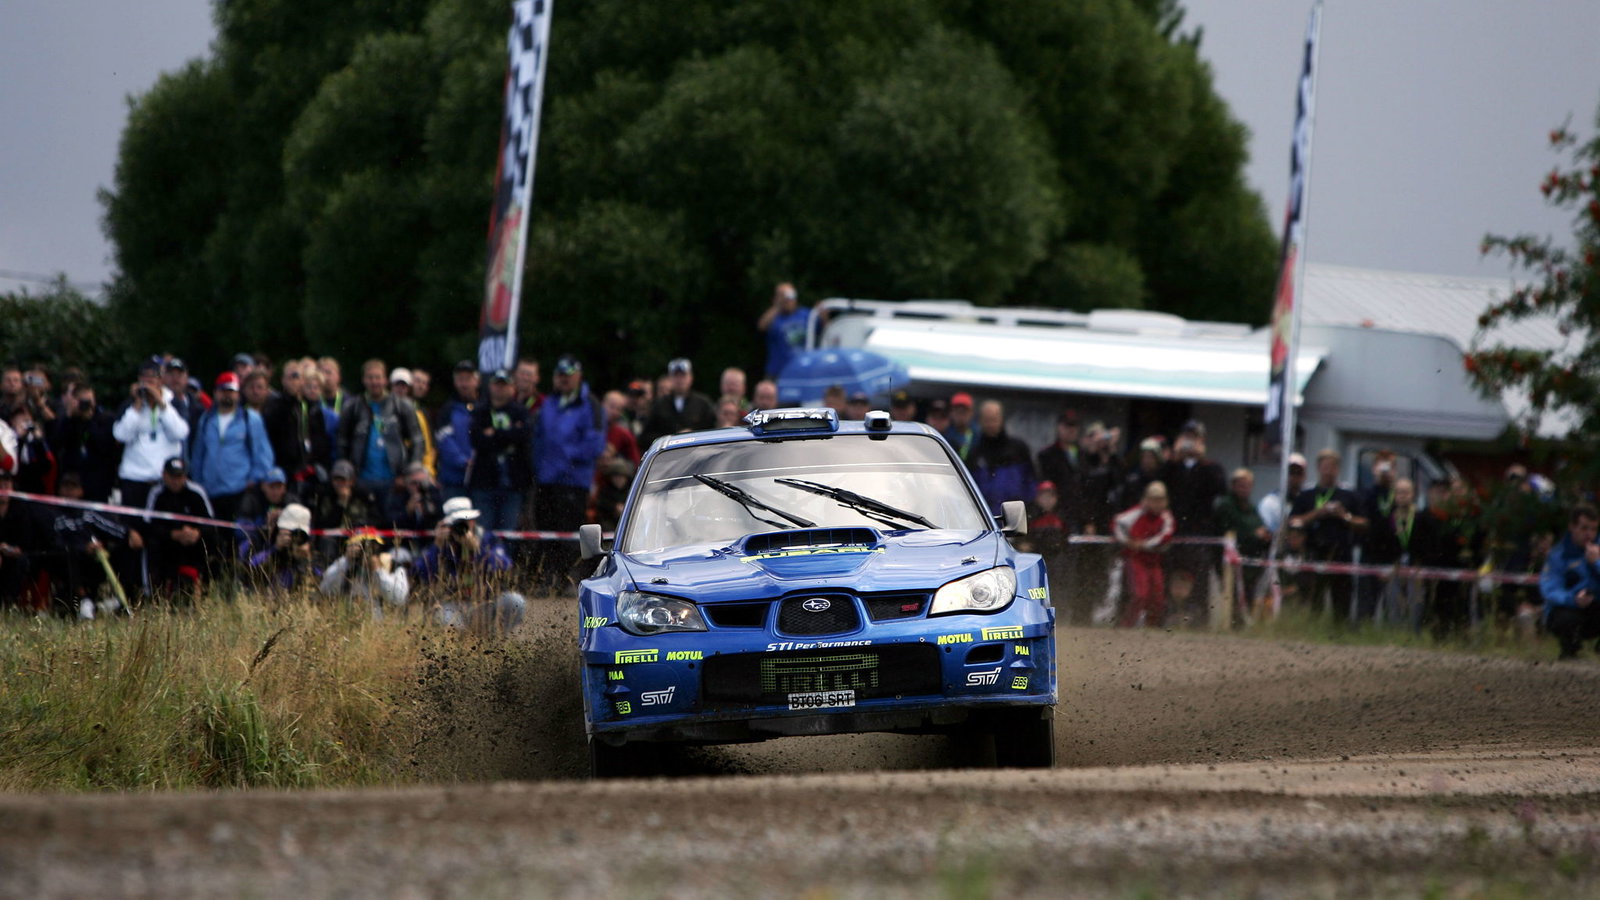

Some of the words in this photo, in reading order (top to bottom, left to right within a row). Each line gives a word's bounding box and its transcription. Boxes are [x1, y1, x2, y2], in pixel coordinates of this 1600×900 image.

[583, 616, 608, 628] DENSO
[937, 633, 974, 645] MOTUL
[981, 626, 1024, 641] PIRELLI
[766, 642, 794, 652] STI
[615, 648, 659, 665] PIRELLI
[666, 651, 704, 661] MOTUL
[827, 692, 852, 706] SRT
